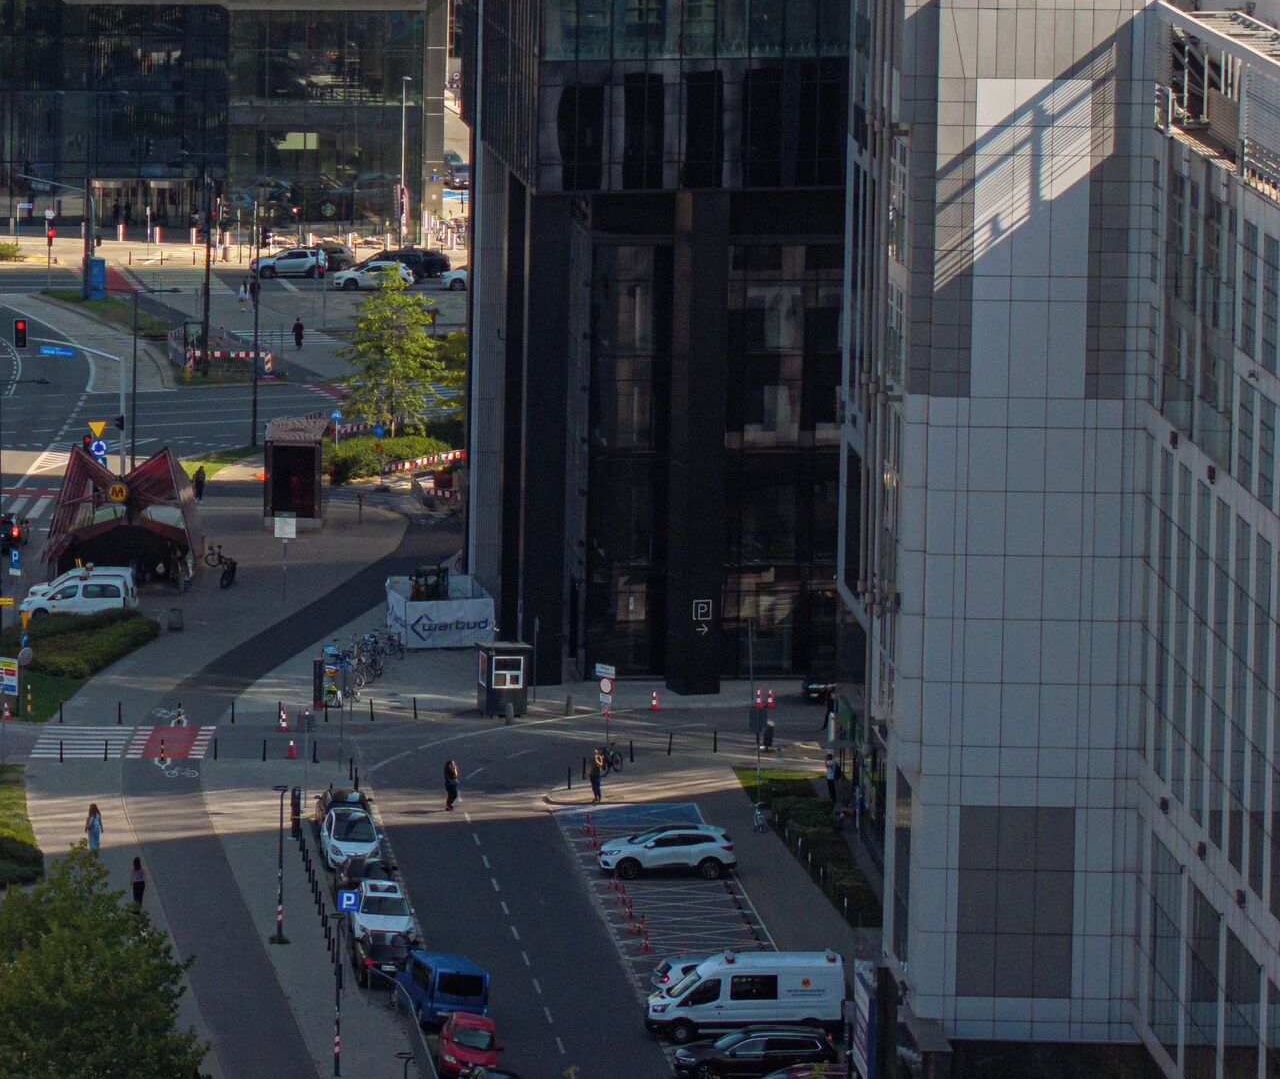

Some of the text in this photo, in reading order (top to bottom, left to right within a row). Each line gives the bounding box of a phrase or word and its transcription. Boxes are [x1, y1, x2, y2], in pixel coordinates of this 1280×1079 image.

[111, 486, 124, 497] M
[12, 551, 19, 562] P
[422, 618, 489, 632] warbud
[342, 892, 355, 908] P
